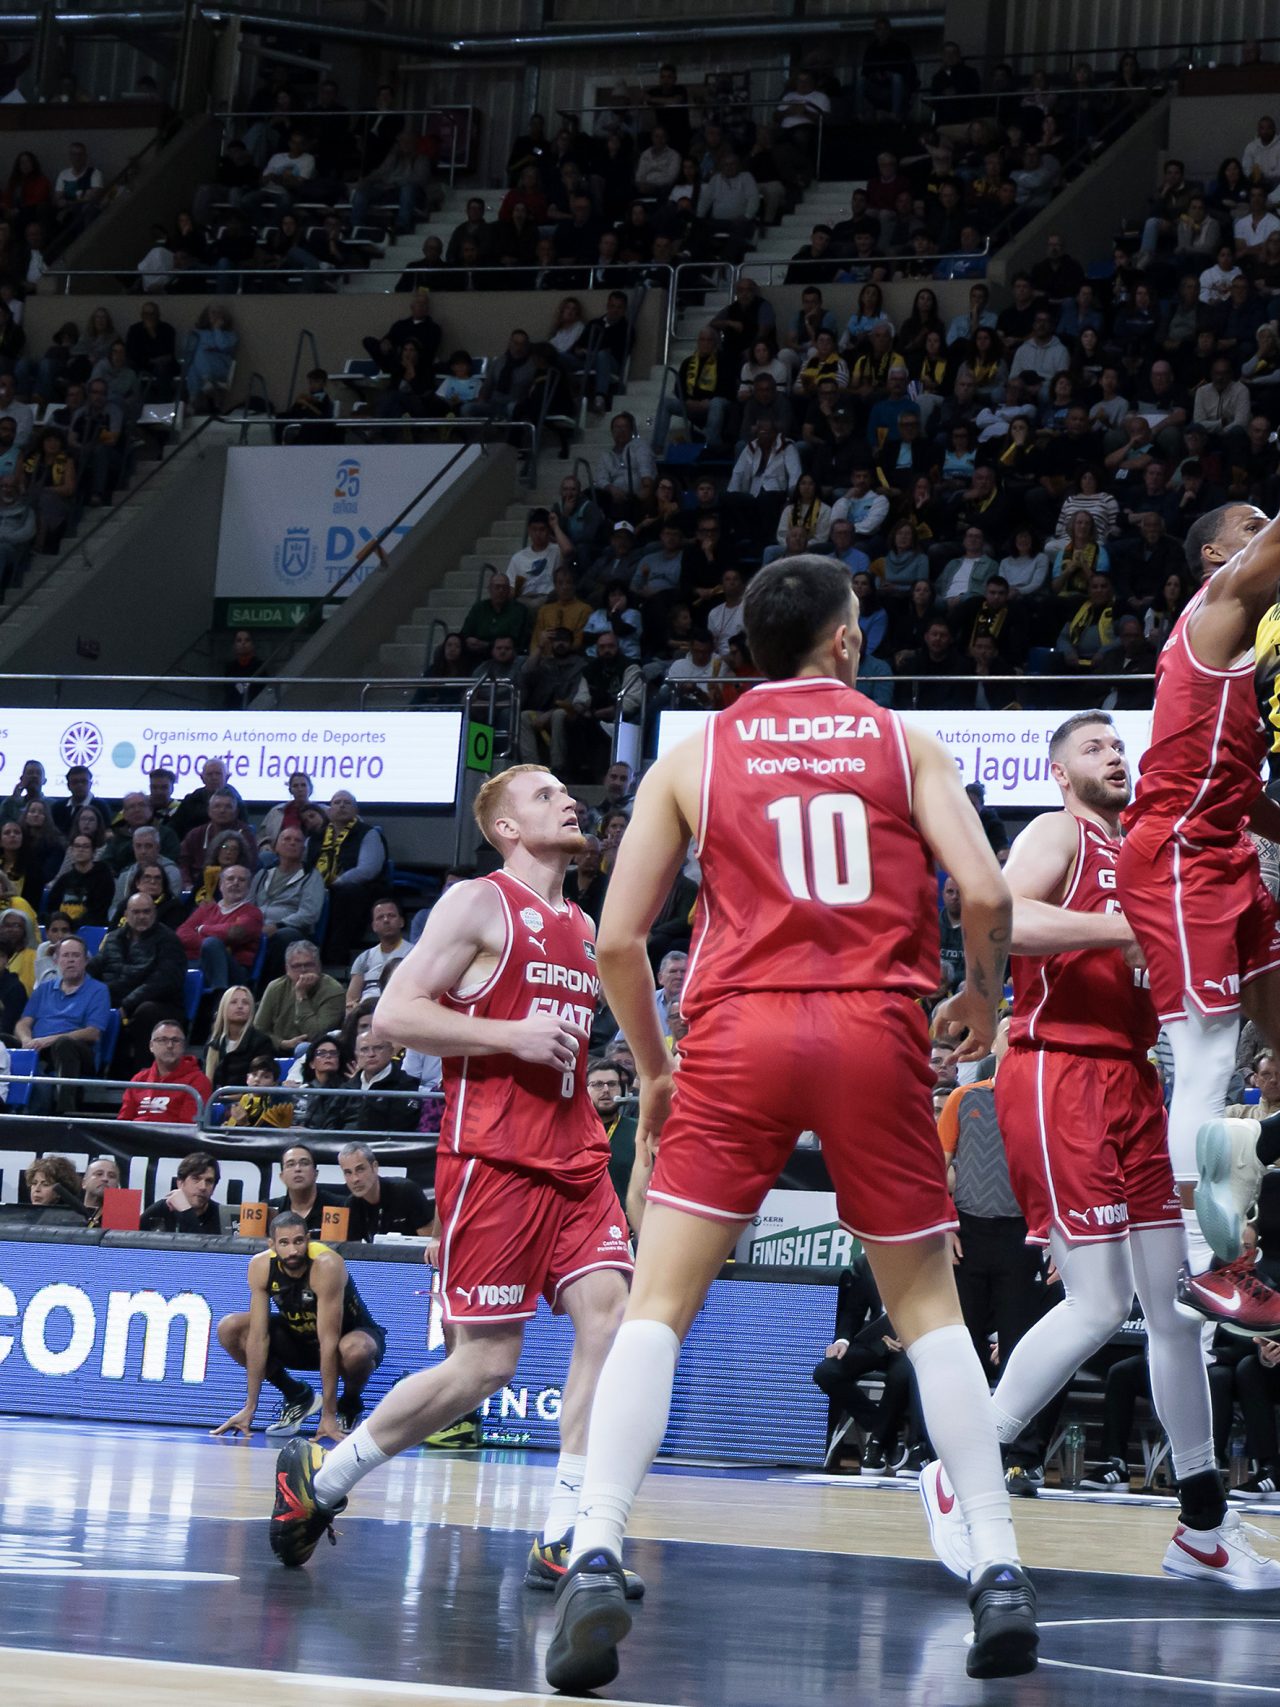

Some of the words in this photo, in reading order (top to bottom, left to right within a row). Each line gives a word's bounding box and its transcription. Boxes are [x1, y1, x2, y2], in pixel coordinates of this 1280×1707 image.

[334, 468, 361, 498] 25
[231, 608, 282, 621] SALIDA
[142, 728, 218, 744] Organismo
[223, 728, 297, 743] Autónomo
[302, 729, 319, 743] de
[323, 730, 386, 746] Deportes
[735, 714, 881, 742] VILDOZA
[936, 729, 1016, 743] Autónomo
[1021, 729, 1040, 743] de
[141, 745, 250, 783] depote
[746, 756, 801, 775] Kave
[802, 756, 866, 775] Home
[766, 791, 873, 907] 10
[241, 1208, 263, 1220] IRS
[752, 1228, 855, 1267] FINISHER
[477, 1283, 526, 1306] YOSOY
